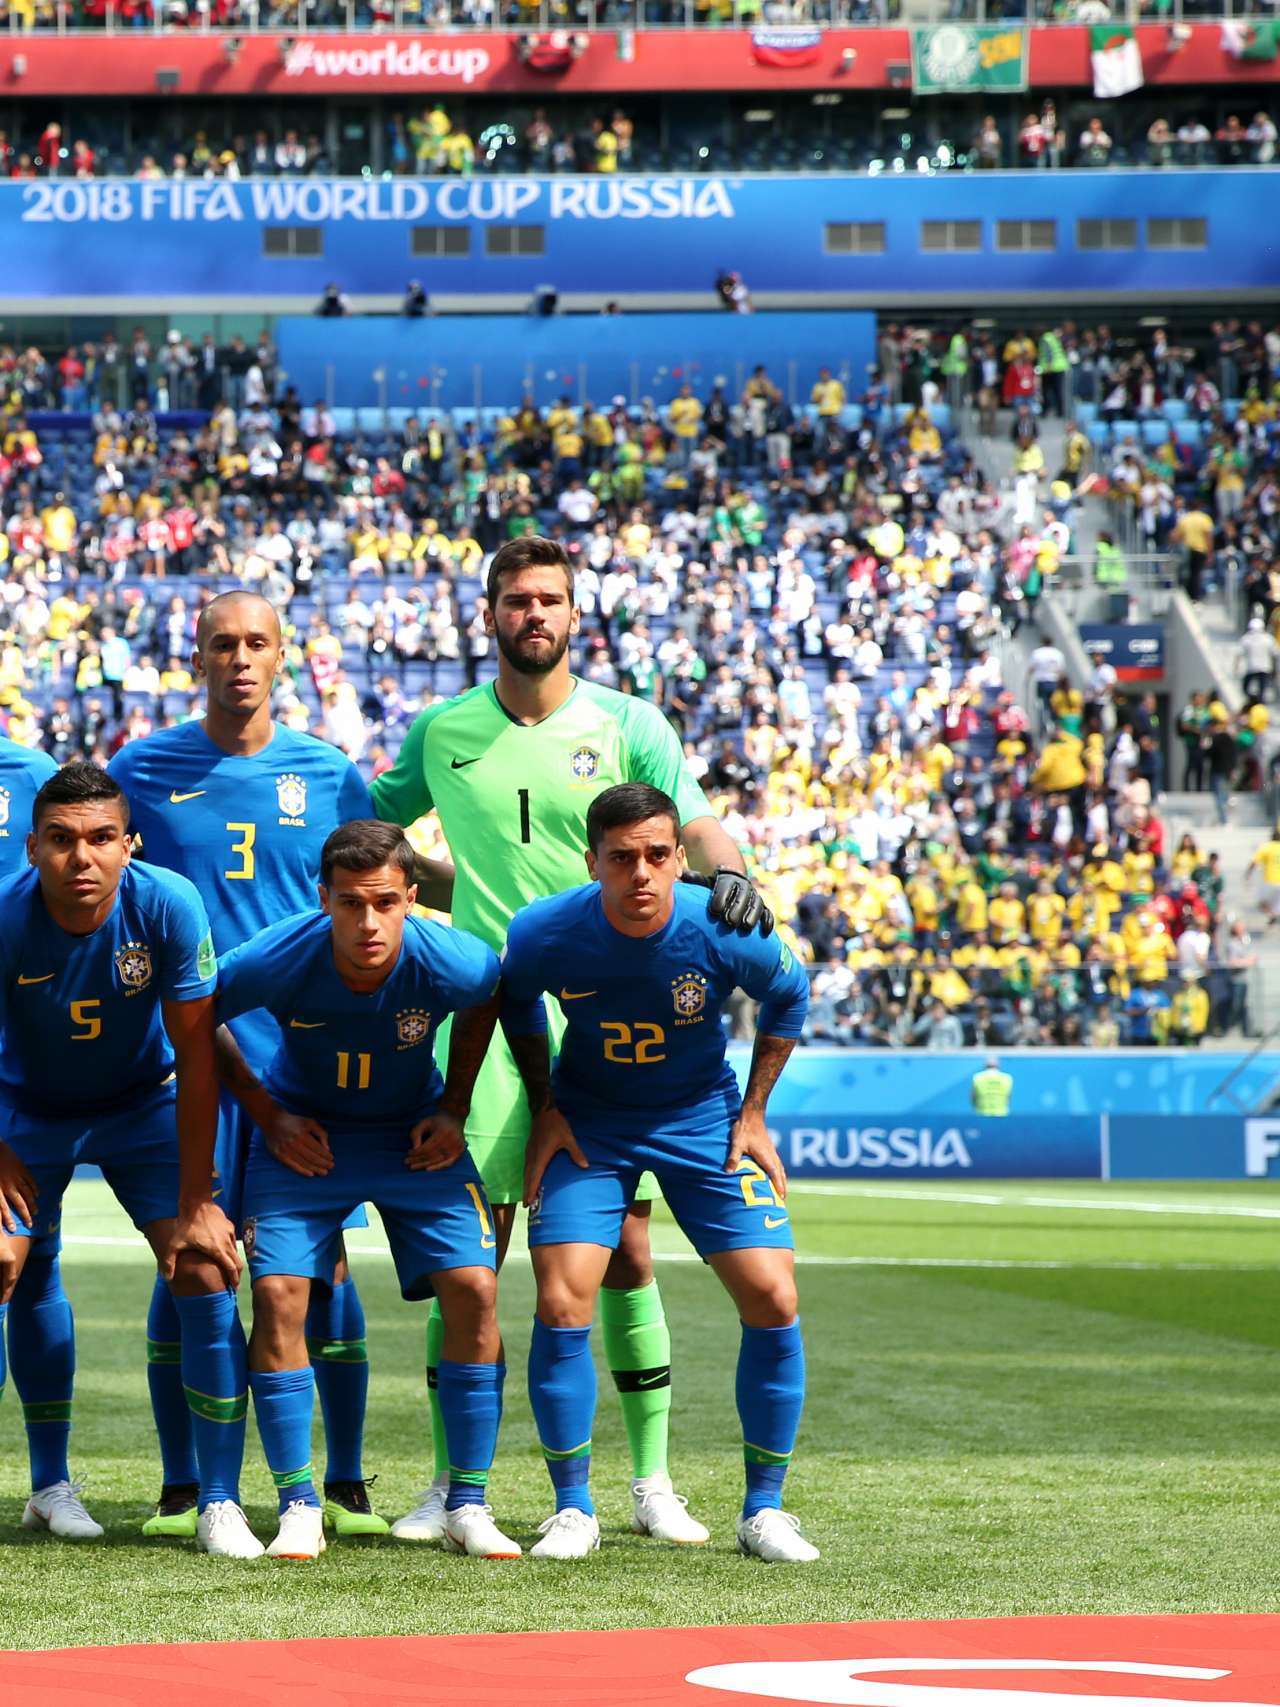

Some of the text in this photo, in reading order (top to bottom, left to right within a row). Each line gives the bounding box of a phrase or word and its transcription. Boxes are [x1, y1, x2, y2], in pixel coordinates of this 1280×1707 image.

[286, 40, 489, 84] #worldcup
[22, 180, 735, 221] 2018 FIFA WORLD CUP RUSSIA
[517, 789, 531, 844] 1
[225, 823, 256, 880] 3
[70, 999, 102, 1041] 5
[599, 1022, 666, 1063] 22
[336, 1051, 372, 1089] 11
[790, 1127, 972, 1167] RUSSIA
